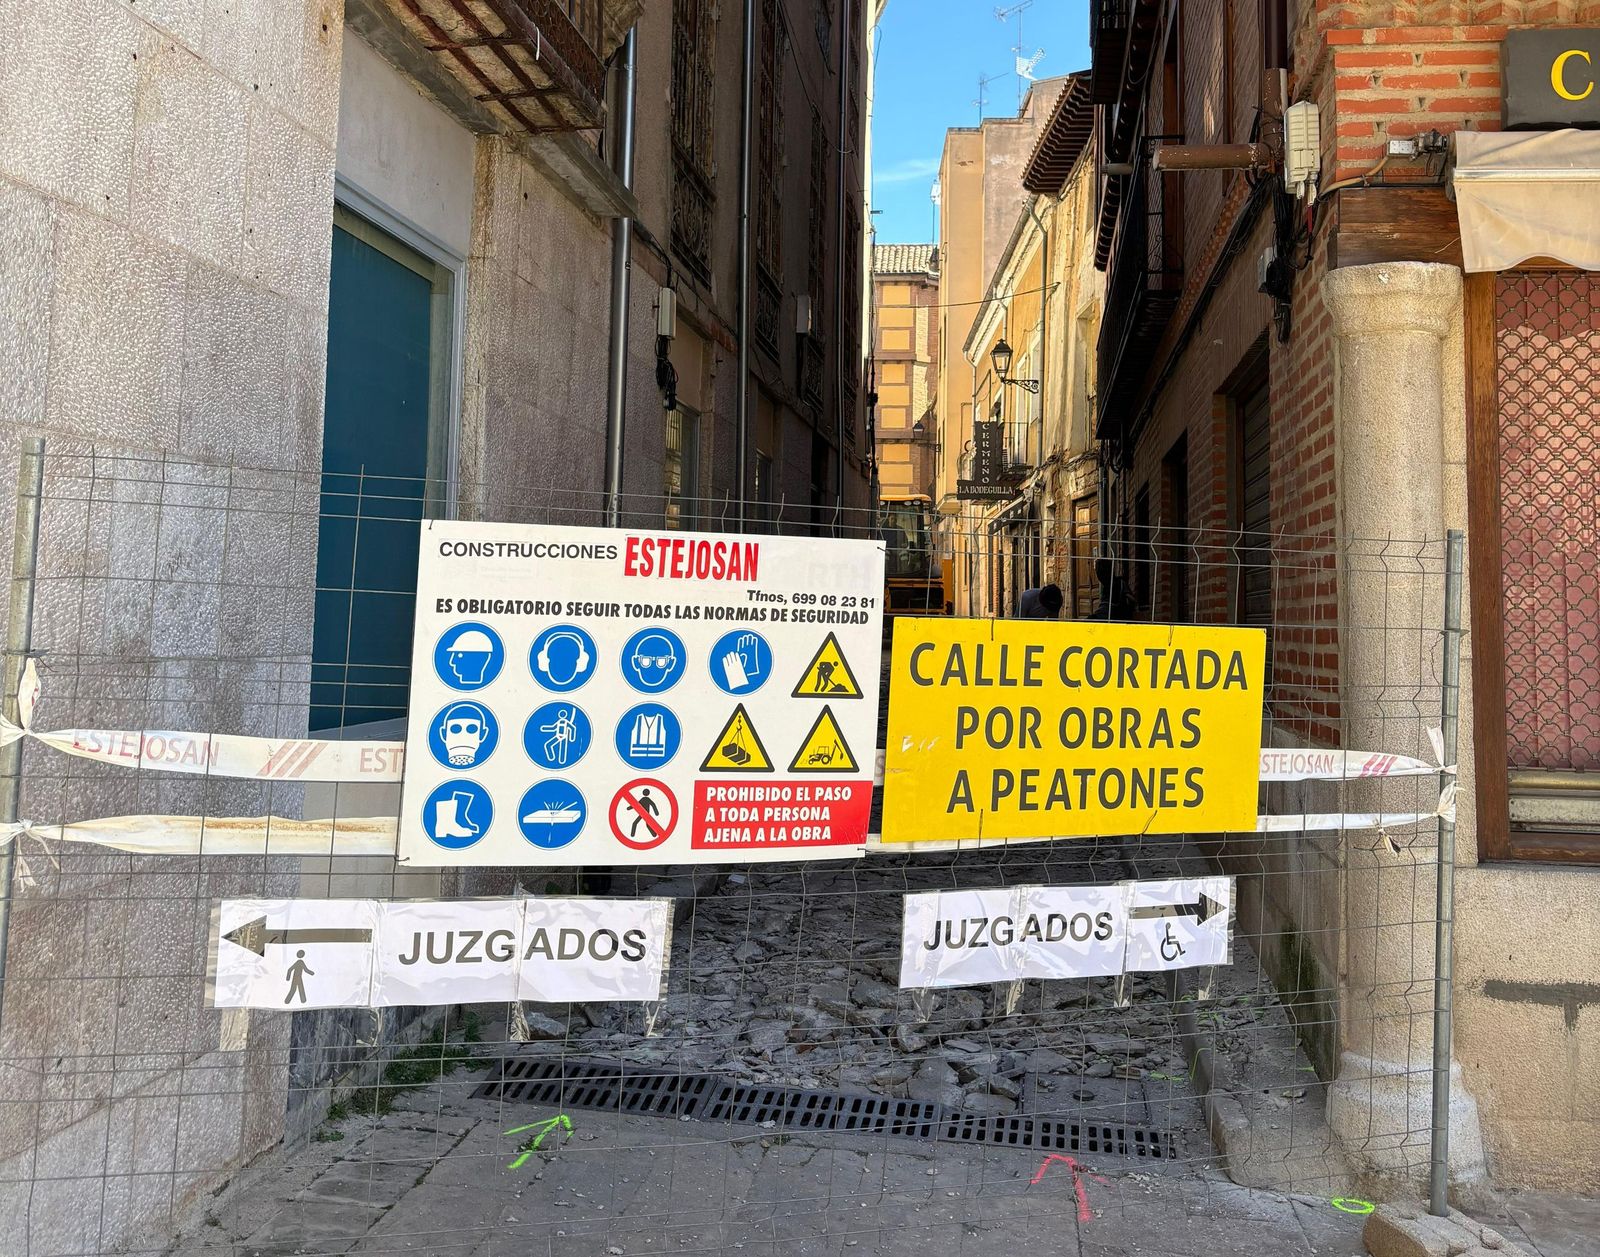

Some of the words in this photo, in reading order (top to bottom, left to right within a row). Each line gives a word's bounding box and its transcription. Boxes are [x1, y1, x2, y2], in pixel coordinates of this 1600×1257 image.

[1550, 49, 1595, 101] C
[959, 486, 969, 494] LA
[970, 486, 1013, 495] BODEGUILLA
[439, 541, 618, 560] CONSTRUCCIONES
[624, 536, 760, 582] ESTEJOSAN
[436, 598, 453, 614] ES
[457, 599, 562, 616] OBLIGATORIO
[565, 601, 621, 617] SEGUIR
[624, 603, 671, 619] TODAS
[675, 605, 700, 620] LAS
[704, 606, 767, 622] NORMAS
[770, 608, 788, 622] DE
[791, 608, 869, 625] SEGURIDAD
[747, 589, 788, 605] Tfnos,
[792, 592, 817, 605] 699
[820, 593, 837, 606] 08
[841, 595, 857, 608] 23
[860, 597, 875, 609] 81
[909, 642, 1045, 687] CALLE
[1058, 646, 1249, 690] CORTADA
[955, 705, 1043, 750] POR
[1058, 706, 1202, 750] OBRAS
[72, 730, 220, 767] ESTEJOSAN
[1259, 753, 1335, 775] STEJOSAN
[706, 786, 792, 802] PROHIBIDO
[796, 786, 810, 801] EL
[815, 786, 852, 801] PASO
[946, 769, 975, 813] A
[991, 766, 1205, 812] PEATONES
[705, 807, 715, 822] A
[720, 807, 759, 822] TODA
[763, 806, 830, 821] PERSONA
[704, 827, 751, 843] AJENA
[755, 827, 765, 842] A
[769, 827, 787, 842] LA
[791, 826, 831, 841] OBRA
[398, 927, 647, 965] JUZGADOS
[923, 911, 1114, 951] JUZGADOS
